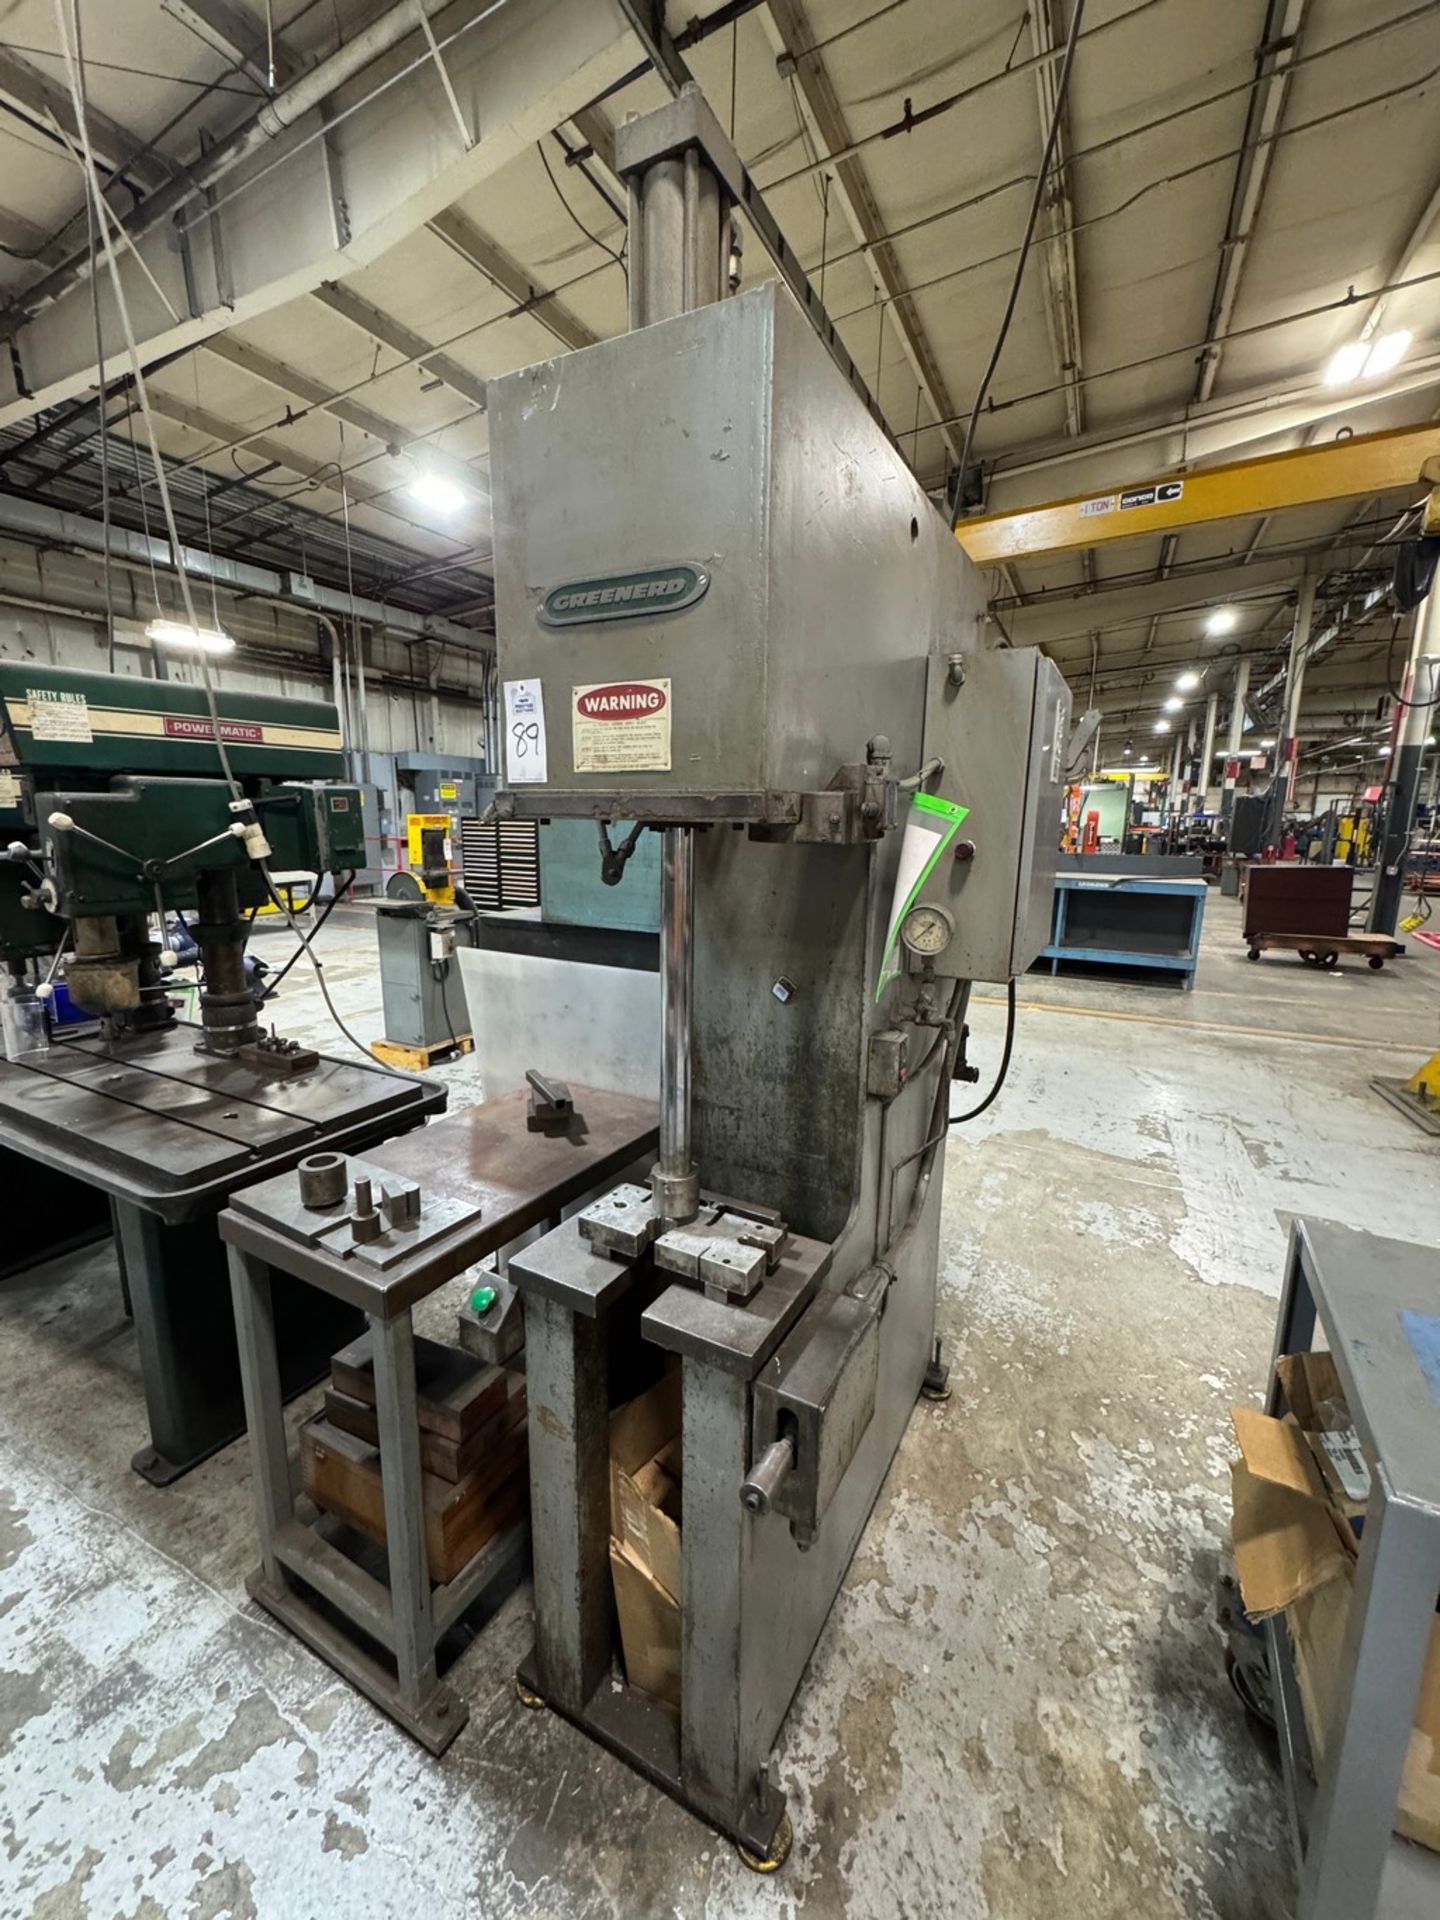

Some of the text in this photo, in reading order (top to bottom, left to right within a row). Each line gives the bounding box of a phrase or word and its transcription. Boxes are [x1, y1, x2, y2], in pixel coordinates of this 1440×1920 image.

[1091, 500, 1110, 513] TON
[553, 578, 687, 610] GREENERD
[26, 688, 87, 705] SAFETY RULES
[584, 692, 661, 714] WARNING
[512, 722, 540, 757] 89
